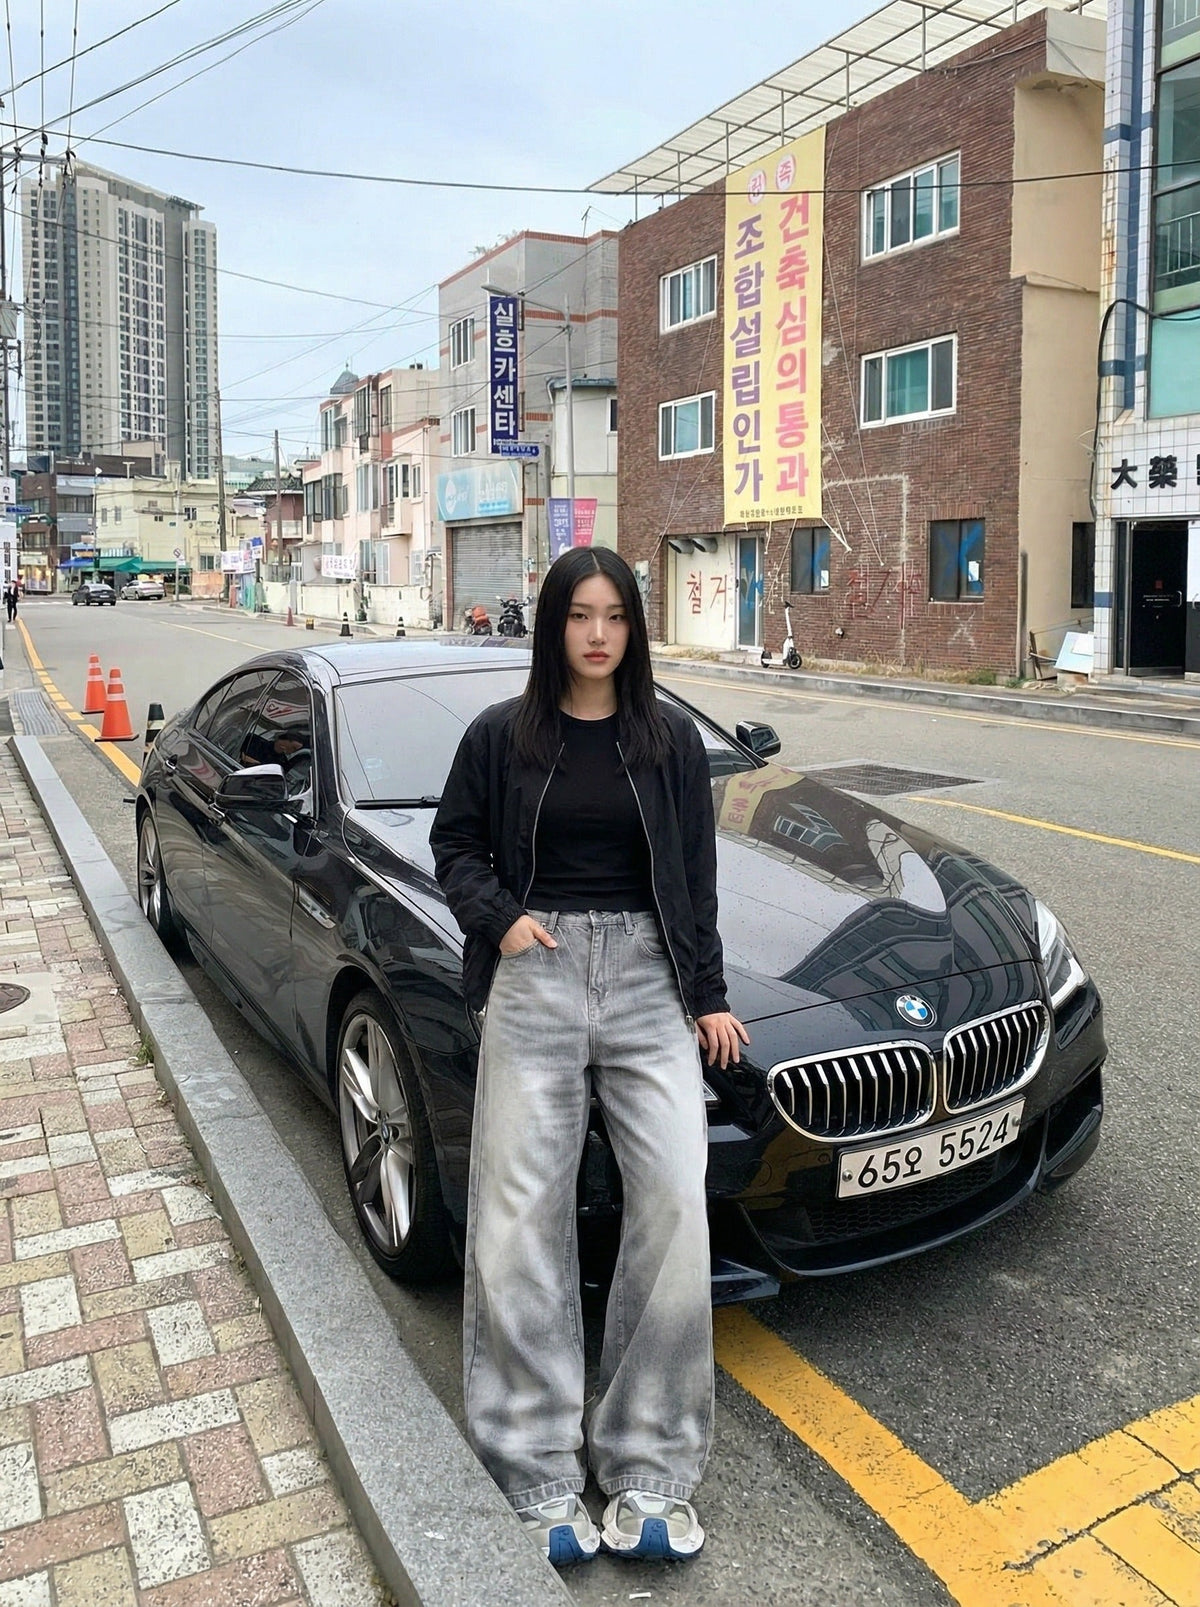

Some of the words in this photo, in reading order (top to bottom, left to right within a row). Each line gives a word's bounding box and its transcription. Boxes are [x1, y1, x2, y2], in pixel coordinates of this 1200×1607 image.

[729, 214, 764, 503] 조합설립인가
[774, 190, 810, 498] 건축심의통과
[1110, 454, 1200, 490] 大藥
[939, 1112, 1009, 1168] 5524
